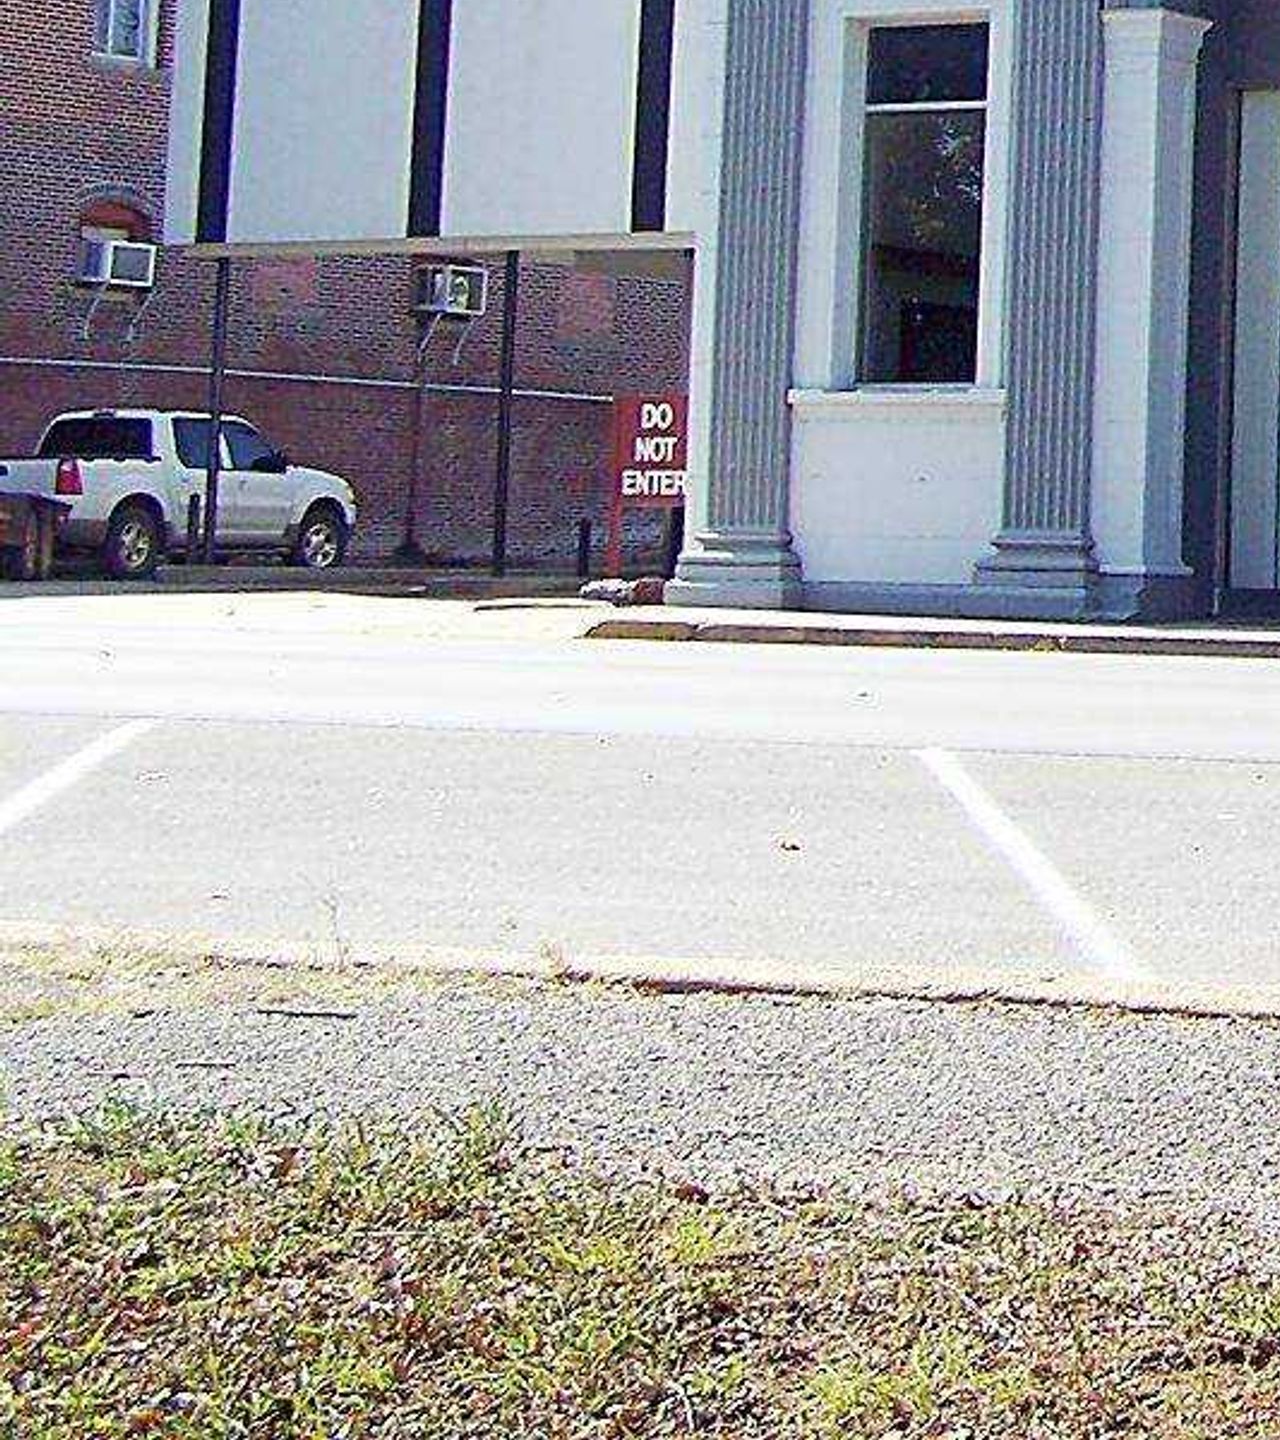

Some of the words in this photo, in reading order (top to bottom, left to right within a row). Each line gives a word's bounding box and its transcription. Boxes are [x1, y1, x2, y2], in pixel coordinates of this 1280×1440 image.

[641, 402, 674, 431] DO
[634, 436, 678, 463] NOT
[621, 469, 688, 496] ENTER
